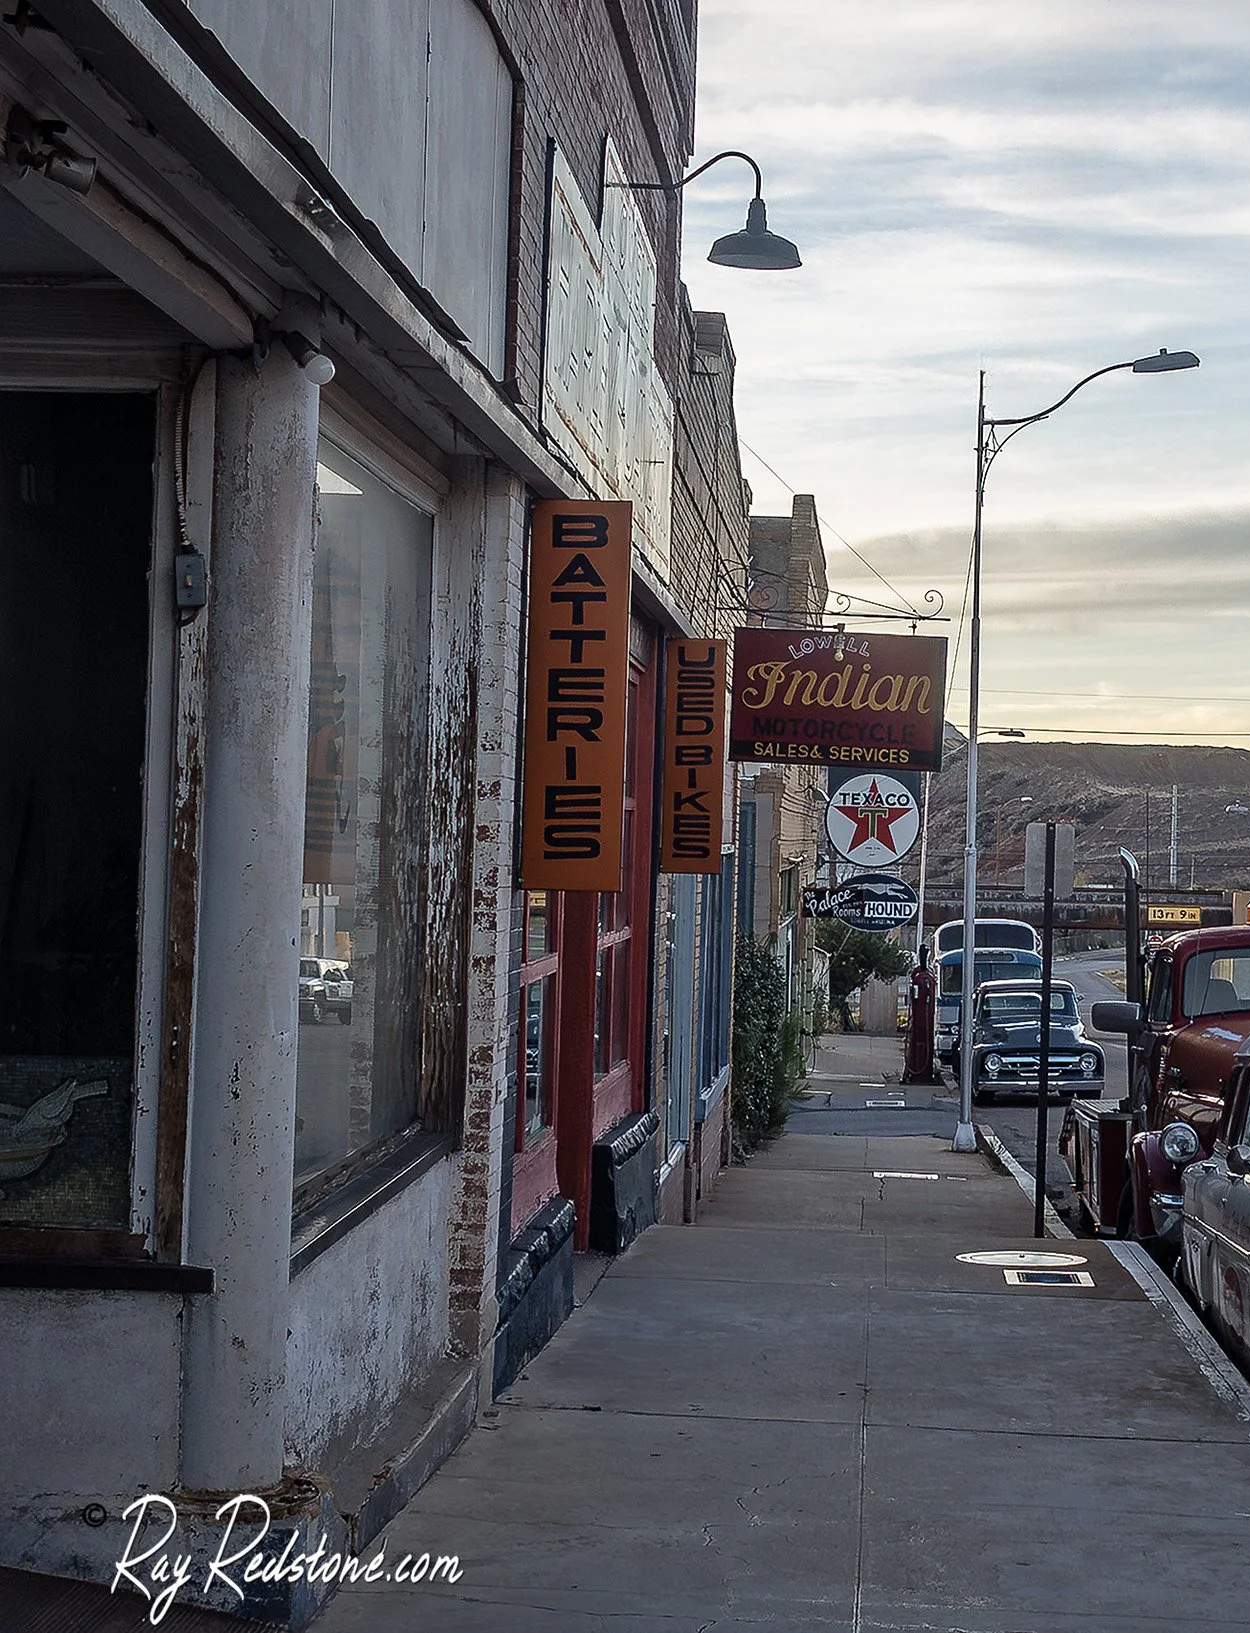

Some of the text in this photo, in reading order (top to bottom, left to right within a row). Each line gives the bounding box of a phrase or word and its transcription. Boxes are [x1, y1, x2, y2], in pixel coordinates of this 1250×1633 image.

[543, 514, 609, 860] BATTERIES
[742, 660, 932, 714] Indian
[753, 715, 916, 744] MOTORCYCLE
[672, 646, 716, 860] USED BIKES
[829, 746, 910, 763] SERVICES
[839, 792, 910, 806] TEXACO
[806, 889, 855, 917] Palace
[832, 905, 862, 918] Rooms
[866, 903, 913, 917] HOUND
